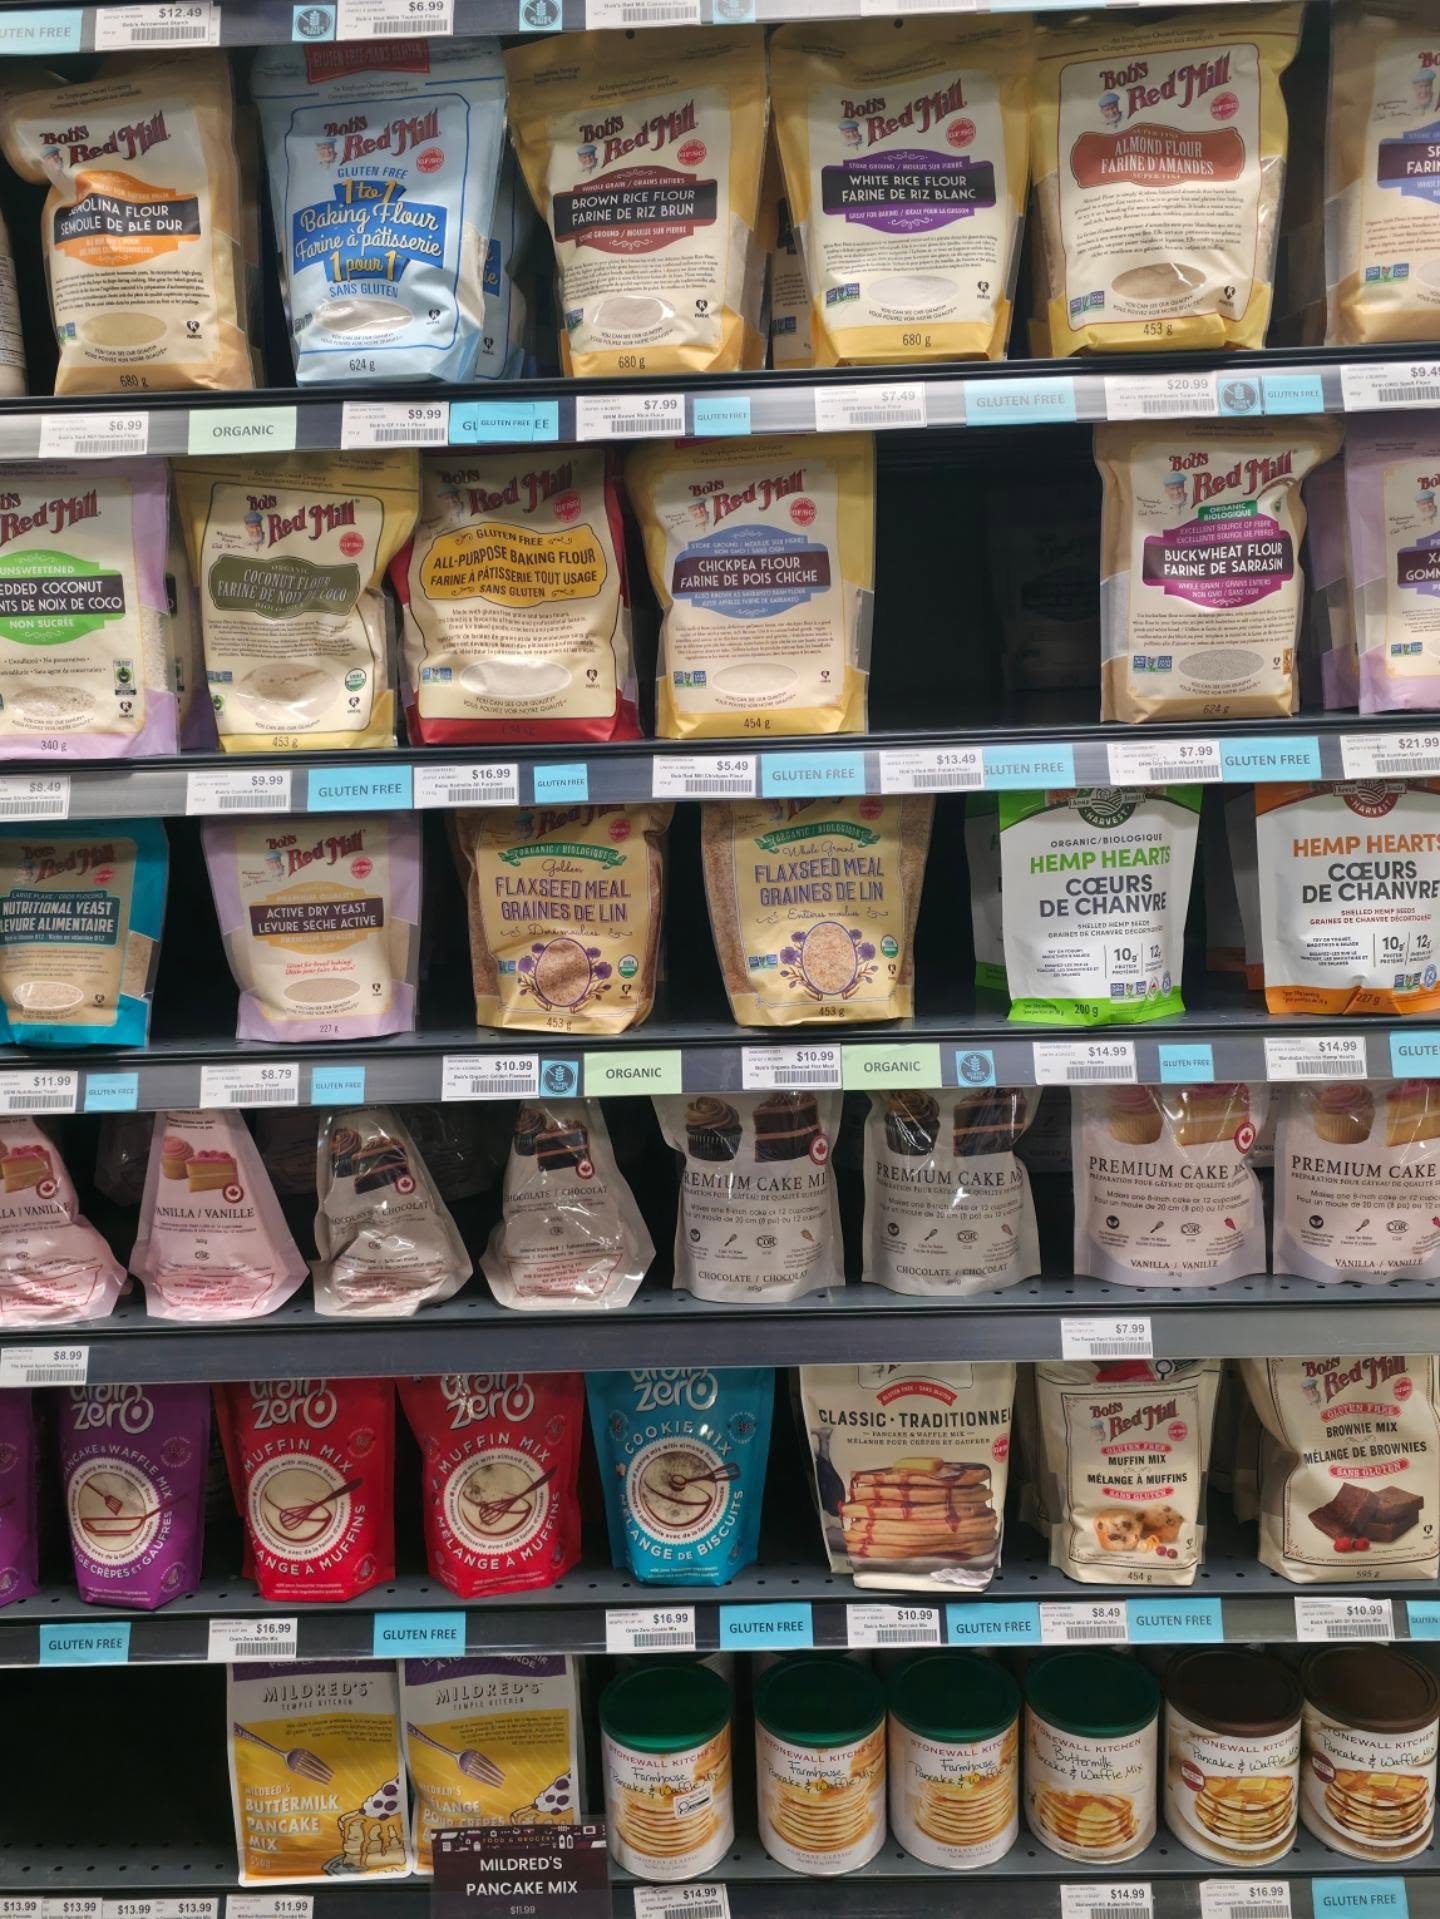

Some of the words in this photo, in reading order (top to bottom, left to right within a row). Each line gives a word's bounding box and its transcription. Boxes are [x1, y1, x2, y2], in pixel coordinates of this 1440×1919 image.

[409, 1, 444, 11] $6.99
[159, 8, 202, 19] $12.49
[40, 25, 71, 39] FREE
[40, 125, 89, 145] Bob's
[68, 130, 119, 168] Red
[118, 110, 169, 160] Mill
[1115, 137, 1162, 155] ALMOND
[1166, 140, 1202, 158] FLOUR
[849, 175, 889, 185] WHITE
[893, 176, 920, 185] RICE
[925, 176, 966, 186] FLOUR
[572, 195, 618, 209] BROWN
[623, 192, 648, 203] RICE
[653, 190, 695, 201] FLOUR
[842, 189, 885, 203] FARINE
[890, 190, 905, 200] DE
[910, 190, 930, 200] RIZ
[935, 189, 976, 199] BLANC
[301, 203, 370, 234] Baking
[373, 203, 439, 231] Flour
[572, 208, 611, 225] FARINE
[616, 208, 632, 219] DE
[636, 206, 655, 218] RIZ
[660, 203, 694, 216] BRUN
[61, 217, 101, 235] SEMOULE
[107, 218, 123, 232] DE
[129, 218, 150, 232] BLÉ
[156, 220, 183, 231] DUR
[1167, 379, 1208, 390] $20.99
[976, 396, 1029, 408] GLUTEN
[1034, 393, 1065, 405] FREE
[1267, 390, 1298, 399] GLUTEN
[1301, 389, 1319, 398] FREE
[644, 400, 677, 410] $7.99
[408, 409, 441, 419] $9.99
[109, 420, 142, 432] $6.99
[1169, 451, 1209, 472] Bob's
[1191, 460, 1242, 509] Red
[1242, 450, 1293, 496] Mill
[433, 545, 508, 569] ALL-PURPOSE
[510, 549, 555, 565] BAKING
[558, 548, 596, 564] FLOUR
[1164, 545, 1243, 563] BUCKWHEAT
[1247, 542, 1283, 556] FLOUR
[0, 565, 75, 575] UNSWEETENED
[698, 560, 755, 573] CHICKPEA
[761, 557, 801, 571] FLOUR
[1164, 564, 1205, 577] FARINE
[1210, 562, 1226, 574] DE
[1231, 558, 1283, 573] SARRASIN
[680, 574, 720, 588] FARINE
[724, 573, 738, 585] DE
[743, 572, 771, 584] POIS
[775, 570, 818, 583] CHICHE
[479, 584, 506, 596] SANS
[509, 586, 546, 598] GLUTEN
[22, 600, 35, 612] DE
[39, 599, 67, 611] NOIX
[71, 598, 84, 609] DE
[88, 597, 122, 609] COCO
[1180, 746, 1213, 757] $7.99
[716, 760, 748, 772] $5.49
[936, 754, 976, 765] $13.49
[472, 768, 510, 780] $16.99
[1034, 762, 1065, 773] FREE
[29, 782, 61, 792] $8.49
[251, 775, 284, 786] $9.99
[1030, 851, 1096, 874] HEMP
[1102, 846, 1171, 868] HEARTS
[541, 859, 585, 877] Golden
[495, 876, 581, 899] FLAXSEED
[585, 879, 631, 898] MEAL
[1066, 874, 1153, 896] CŒURS
[2, 901, 72, 916] NUTRITIONAL
[76, 901, 113, 916] YEAST
[267, 906, 304, 919] ACTIVE
[308, 905, 330, 916] DRY
[333, 902, 367, 915] YEAST
[1040, 900, 1069, 918] DE
[1075, 892, 1167, 917] CHANVRE
[1341, 908, 1373, 916] SHELLED
[0, 918, 36, 933] LEVURE
[37, 918, 114, 933] ALIMENTAIRE
[258, 920, 299, 934] LEVURE
[340, 915, 377, 928] ACTIVE
[796, 1051, 834, 1062] $10.99
[1088, 1046, 1127, 1057] $14.99
[1398, 1045, 1440, 1057] GLUTE
[495, 1061, 533, 1072] $10.99
[863, 1062, 921, 1073] ORGANIC
[33, 1076, 72, 1087] $11.99
[261, 1069, 292, 1080] $8.79
[1291, 1155, 1382, 1178] PREMIUM
[1389, 1164, 1436, 1179] CAKE
[561, 1185, 608, 1198] CHOCOLAT
[205, 1207, 254, 1219] VANILLE
[1115, 1324, 1145, 1334] $7.99
[54, 1350, 82, 1360] $8.99
[71, 1397, 154, 1434] zero
[1326, 1422, 1372, 1438] BROWNIE
[1375, 1421, 1398, 1433] MIX
[625, 1421, 693, 1454] COOKIE
[438, 1432, 510, 1474] MUFFIN
[519, 1437, 551, 1463] MIX
[1108, 1455, 1145, 1466] MUFFIN
[1148, 1454, 1166, 1464] MIX
[1303, 1449, 1349, 1465] MÉLANGE
[1352, 1447, 1367, 1459] DE
[1370, 1442, 1427, 1457] BROWNIES
[256, 1623, 291, 1634] $16.99
[48, 1639, 93, 1651] GLUTEN
[96, 1637, 123, 1649] FREE
[764, 1736, 824, 1763] STONEWALL
[829, 1743, 874, 1762] KITCHEN
[1051, 1744, 1113, 1768] Buttermilk
[246, 1795, 339, 1813] BUTTERMILK
[480, 1856, 563, 1872] MILDRED'S
[466, 1882, 544, 1896] PANCAKE
[548, 1881, 578, 1894] MIX
[1110, 1889, 1145, 1899] $14.99
[1249, 1888, 1284, 1897] $16.99
[63, 1901, 96, 1913] $13.99
[274, 1901, 308, 1912] $11.99
[1323, 1896, 1367, 1906] GLUTEN
[1370, 1894, 1397, 1904] FREE
